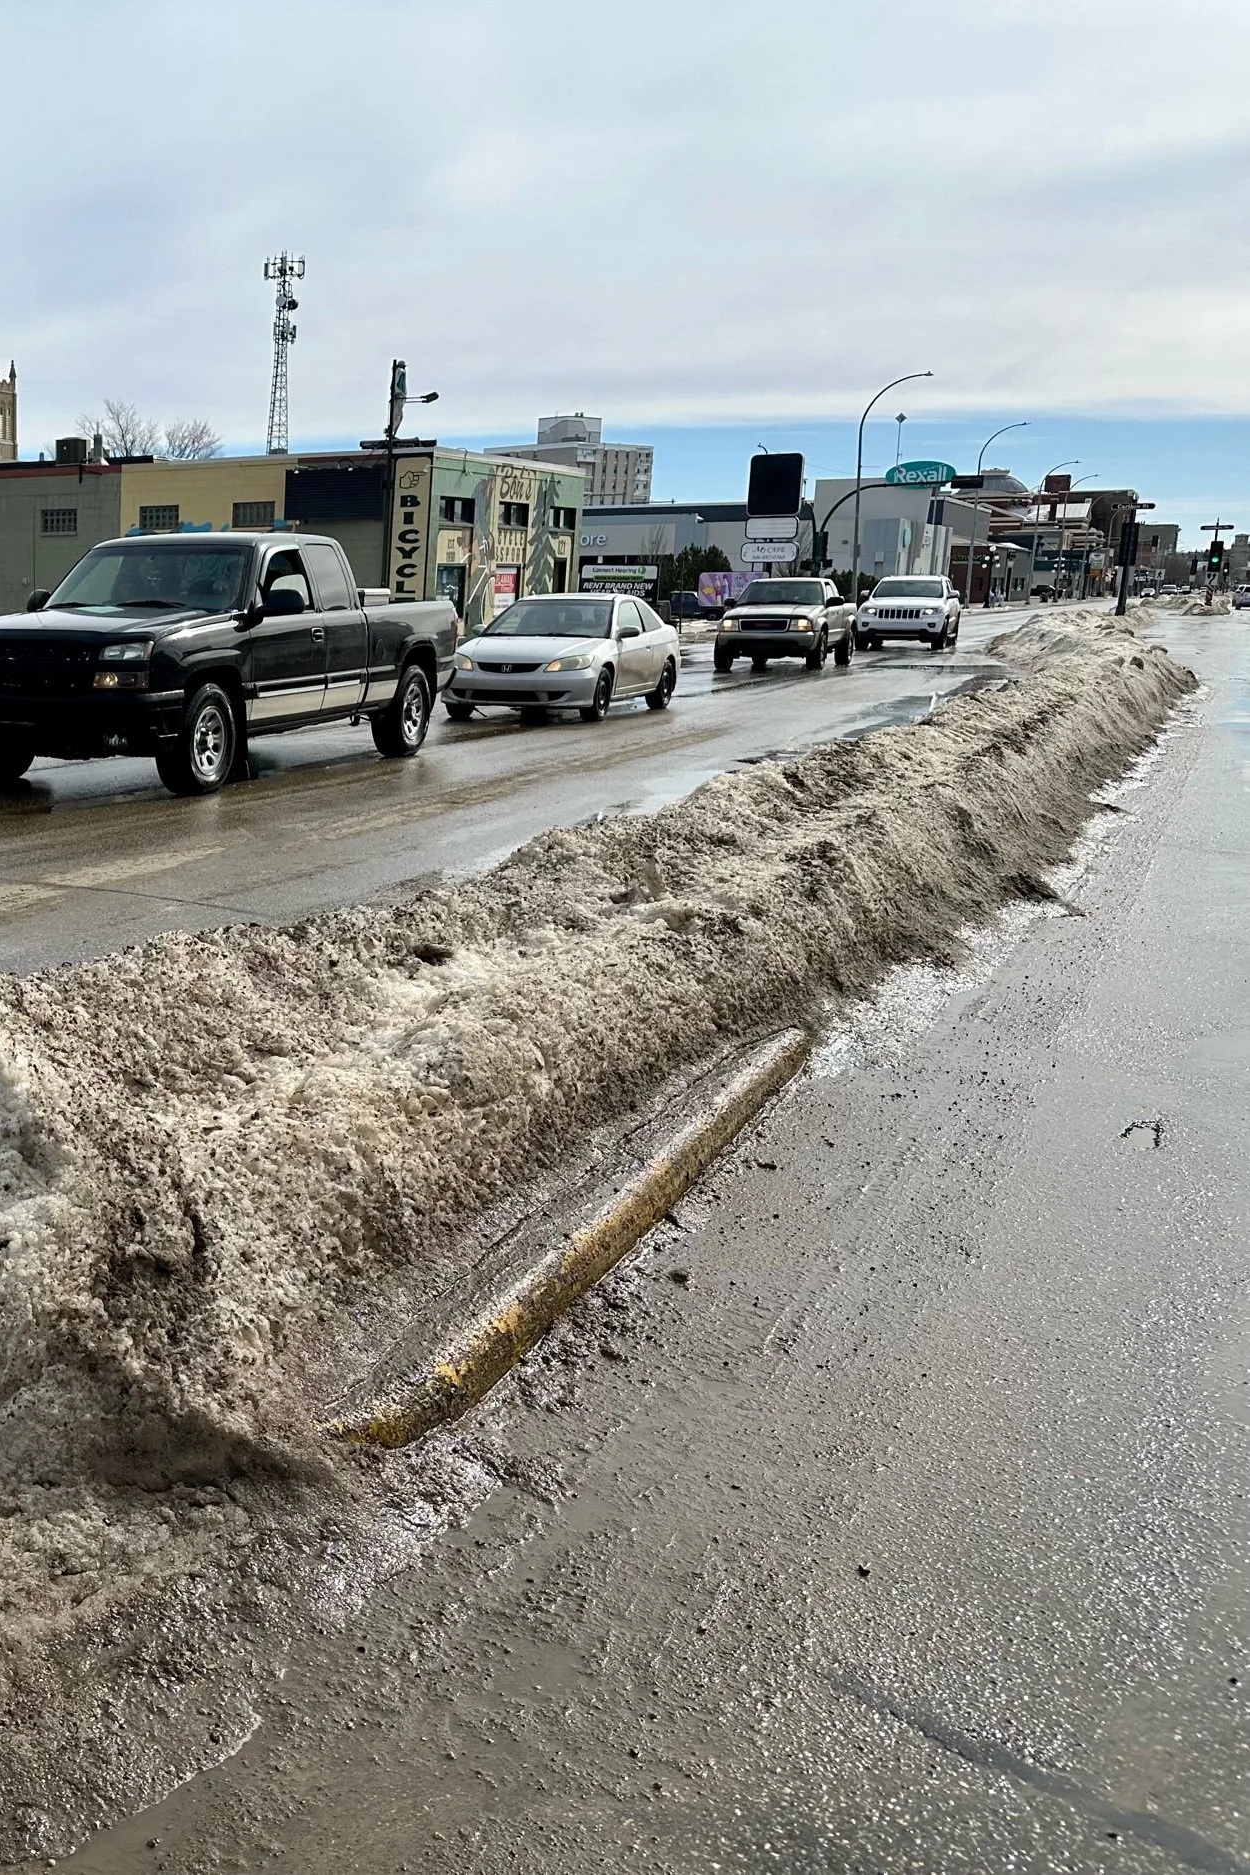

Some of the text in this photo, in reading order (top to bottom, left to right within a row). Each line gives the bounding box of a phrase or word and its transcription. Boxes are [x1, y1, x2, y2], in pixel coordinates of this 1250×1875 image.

[893, 466, 947, 483] Rexall
[498, 530, 524, 546] CYCLE
[395, 495, 421, 601] BICYCL
[605, 582, 633, 590] BRAND
[633, 582, 654, 590] NEW
